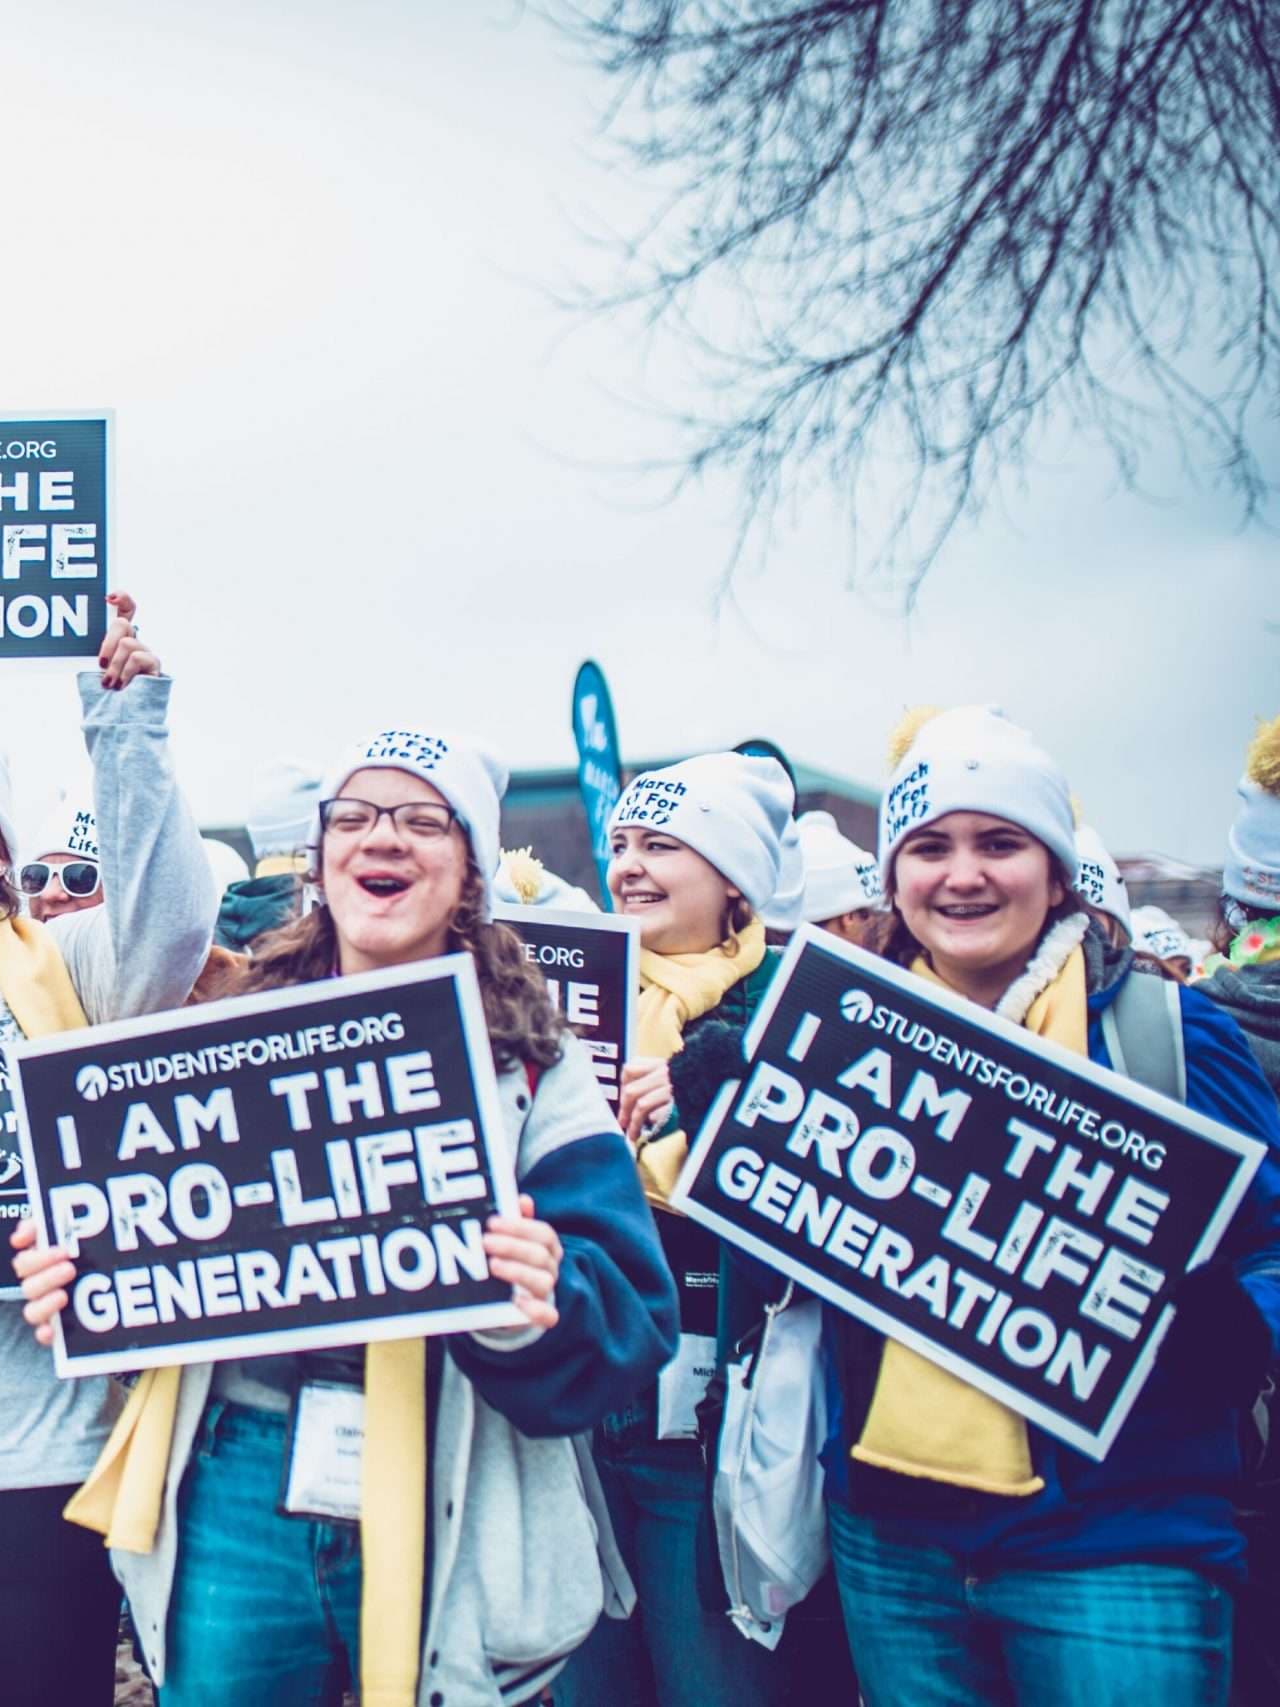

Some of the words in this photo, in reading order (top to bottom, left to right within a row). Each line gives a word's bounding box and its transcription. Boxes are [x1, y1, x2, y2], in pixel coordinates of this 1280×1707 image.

[618, 806, 648, 821] Life
[632, 777, 687, 796] March
[645, 793, 679, 811] For
[901, 783, 929, 810] For
[1080, 873, 1104, 891] For
[1082, 863, 1105, 879] rch
[109, 1012, 405, 1093] STUDENTSFORLIFE.ORG
[870, 1004, 1168, 1171] STUDENTSFORLIFE.ORG
[56, 1114, 82, 1169] I
[117, 1087, 240, 1162] AM
[270, 1050, 441, 1132] THE
[786, 1012, 822, 1062] I
[837, 1047, 972, 1143] AM
[1006, 1116, 1170, 1246] THE
[48, 1117, 487, 1259] PRO-LIFE
[734, 1061, 1166, 1341] PRO-LIFE
[73, 1219, 490, 1333] GENERATION
[715, 1147, 1111, 1402] GENERATION
